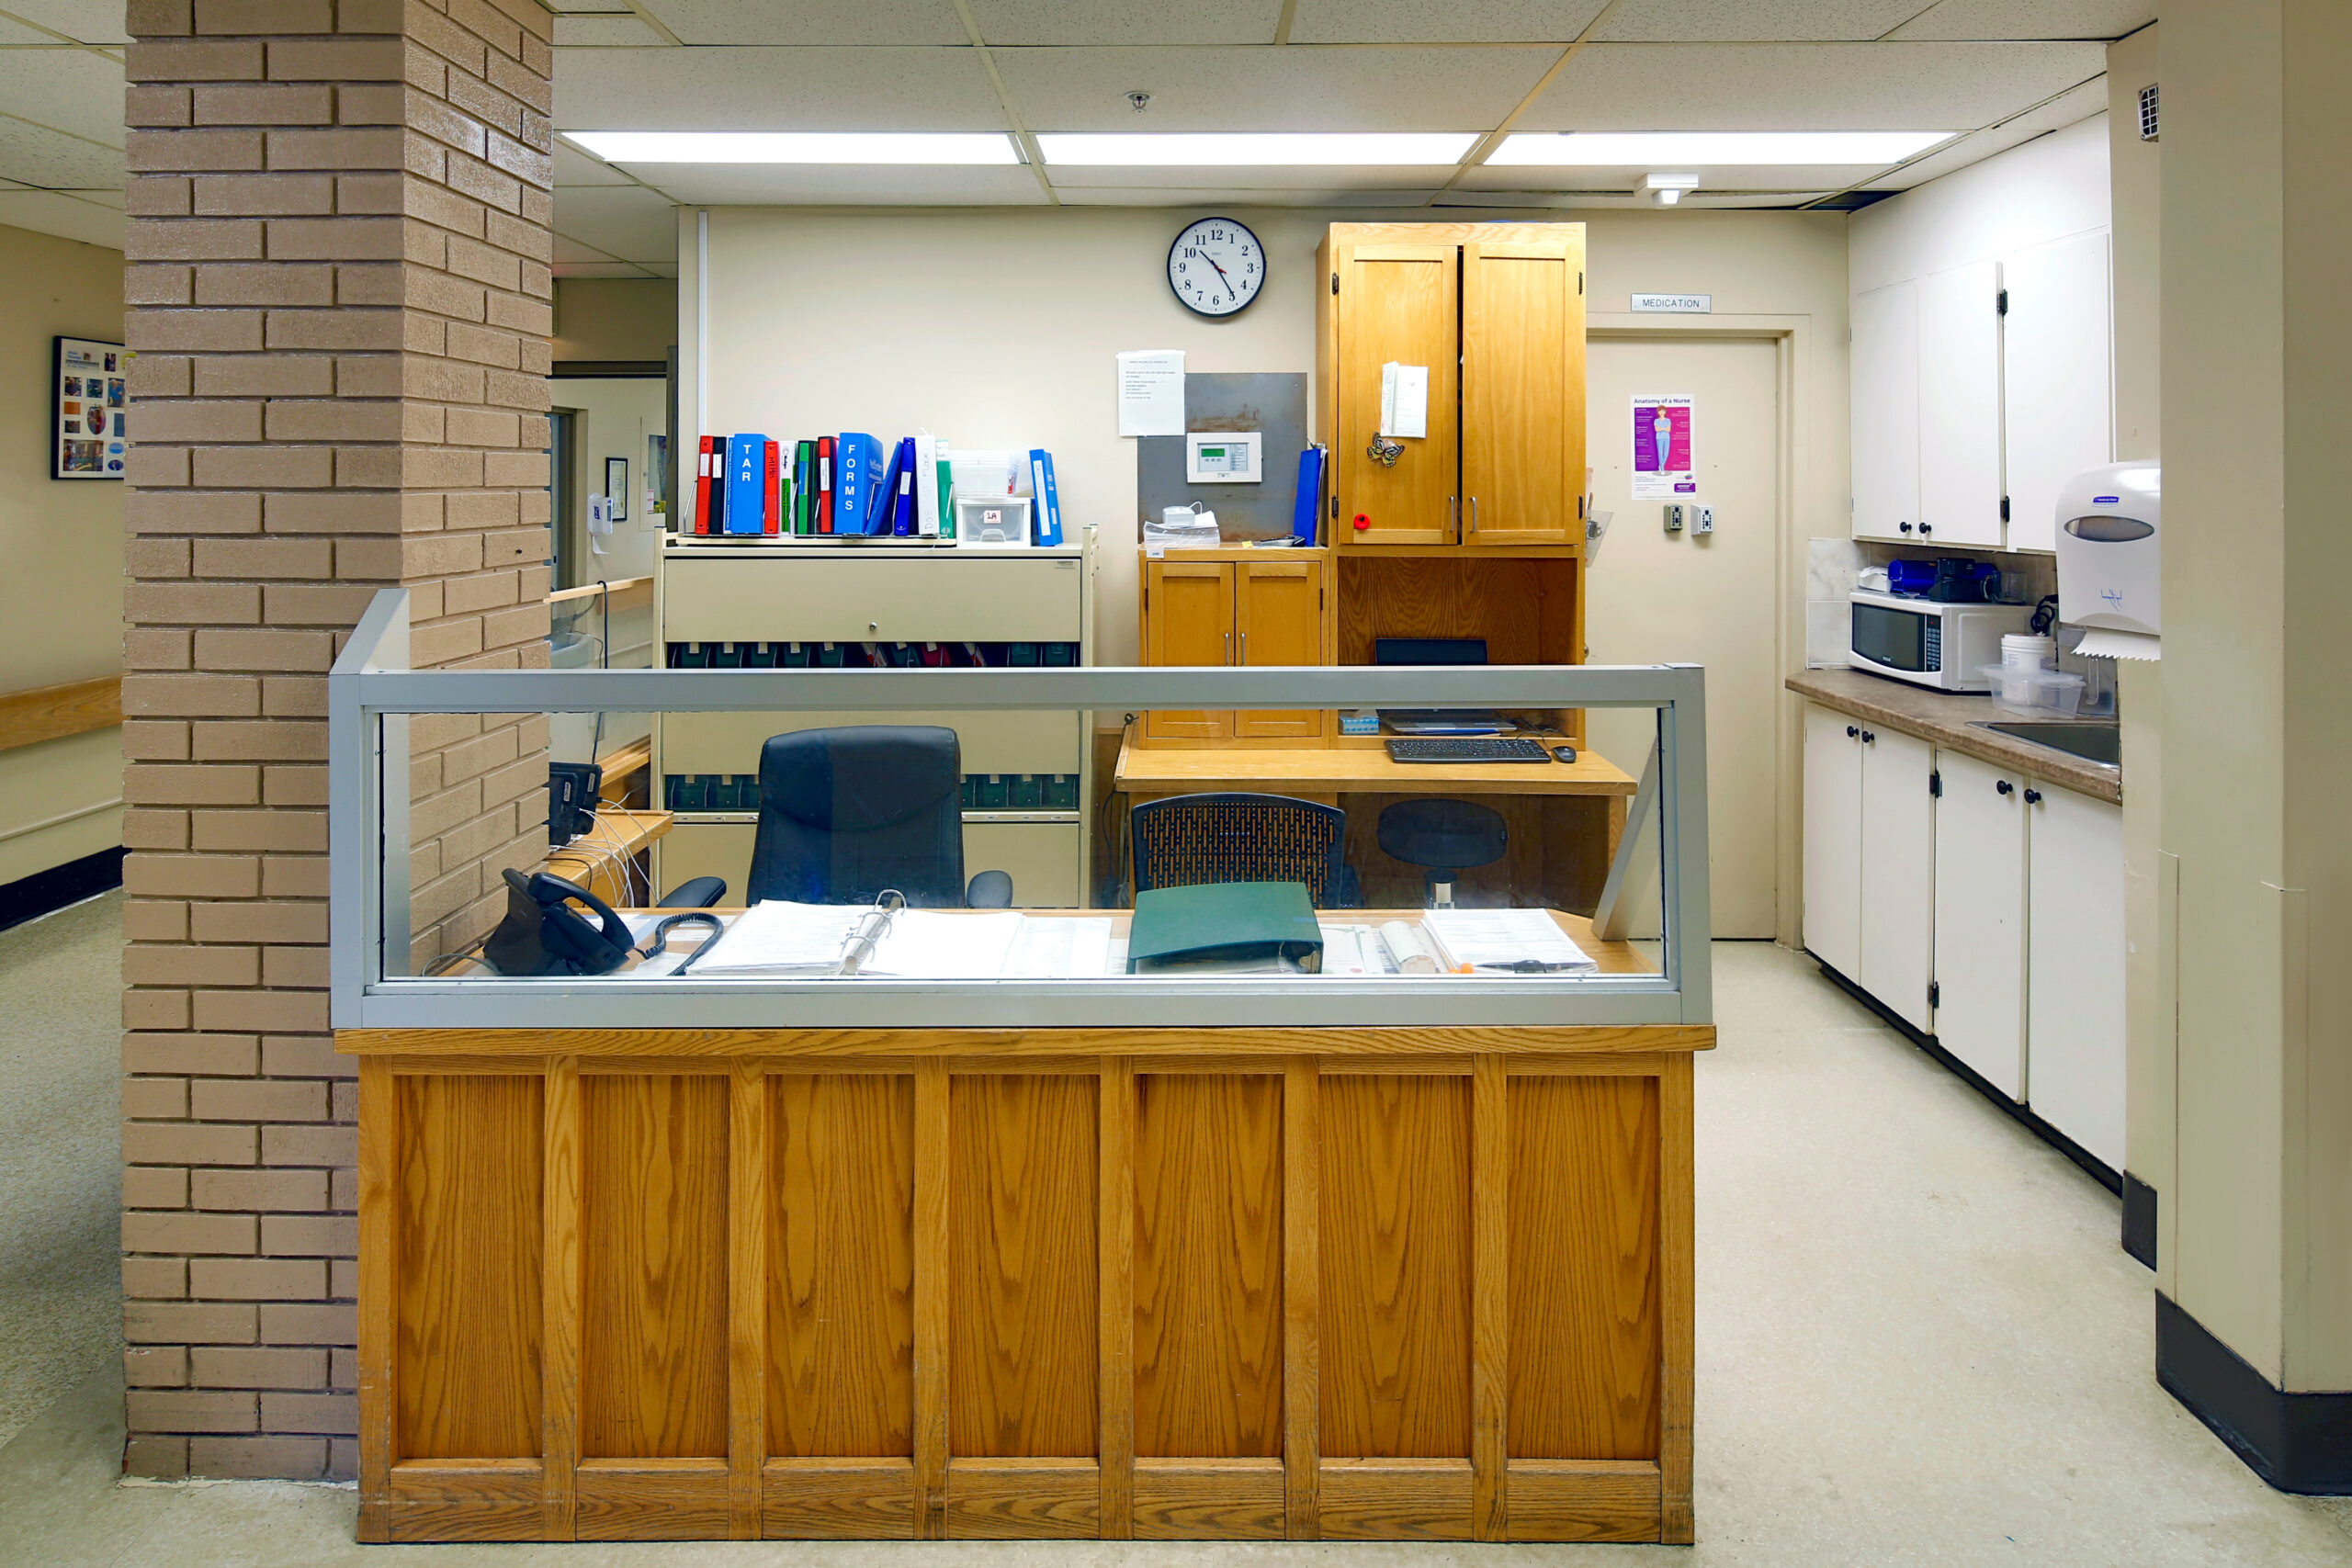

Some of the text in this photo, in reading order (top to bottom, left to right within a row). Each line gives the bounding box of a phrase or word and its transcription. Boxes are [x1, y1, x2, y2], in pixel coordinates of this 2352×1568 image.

[1195, 234, 1206, 245] 11
[1210, 229, 1223, 241] 12
[1229, 233, 1235, 244] 1
[1184, 247, 1196, 258] 10
[1241, 245, 1249, 256] 2
[1179, 262, 1186, 273] 9
[1247, 263, 1254, 274] 3
[1184, 279, 1192, 290] 8
[1240, 279, 1247, 290] 4
[1196, 290, 1204, 301] 7
[1213, 295, 1219, 306] 6
[1228, 290, 1236, 301] 5
[1642, 299, 1700, 308] MEDICATION
[742, 444, 752, 481] TAR
[844, 445, 855, 511] FORMS
